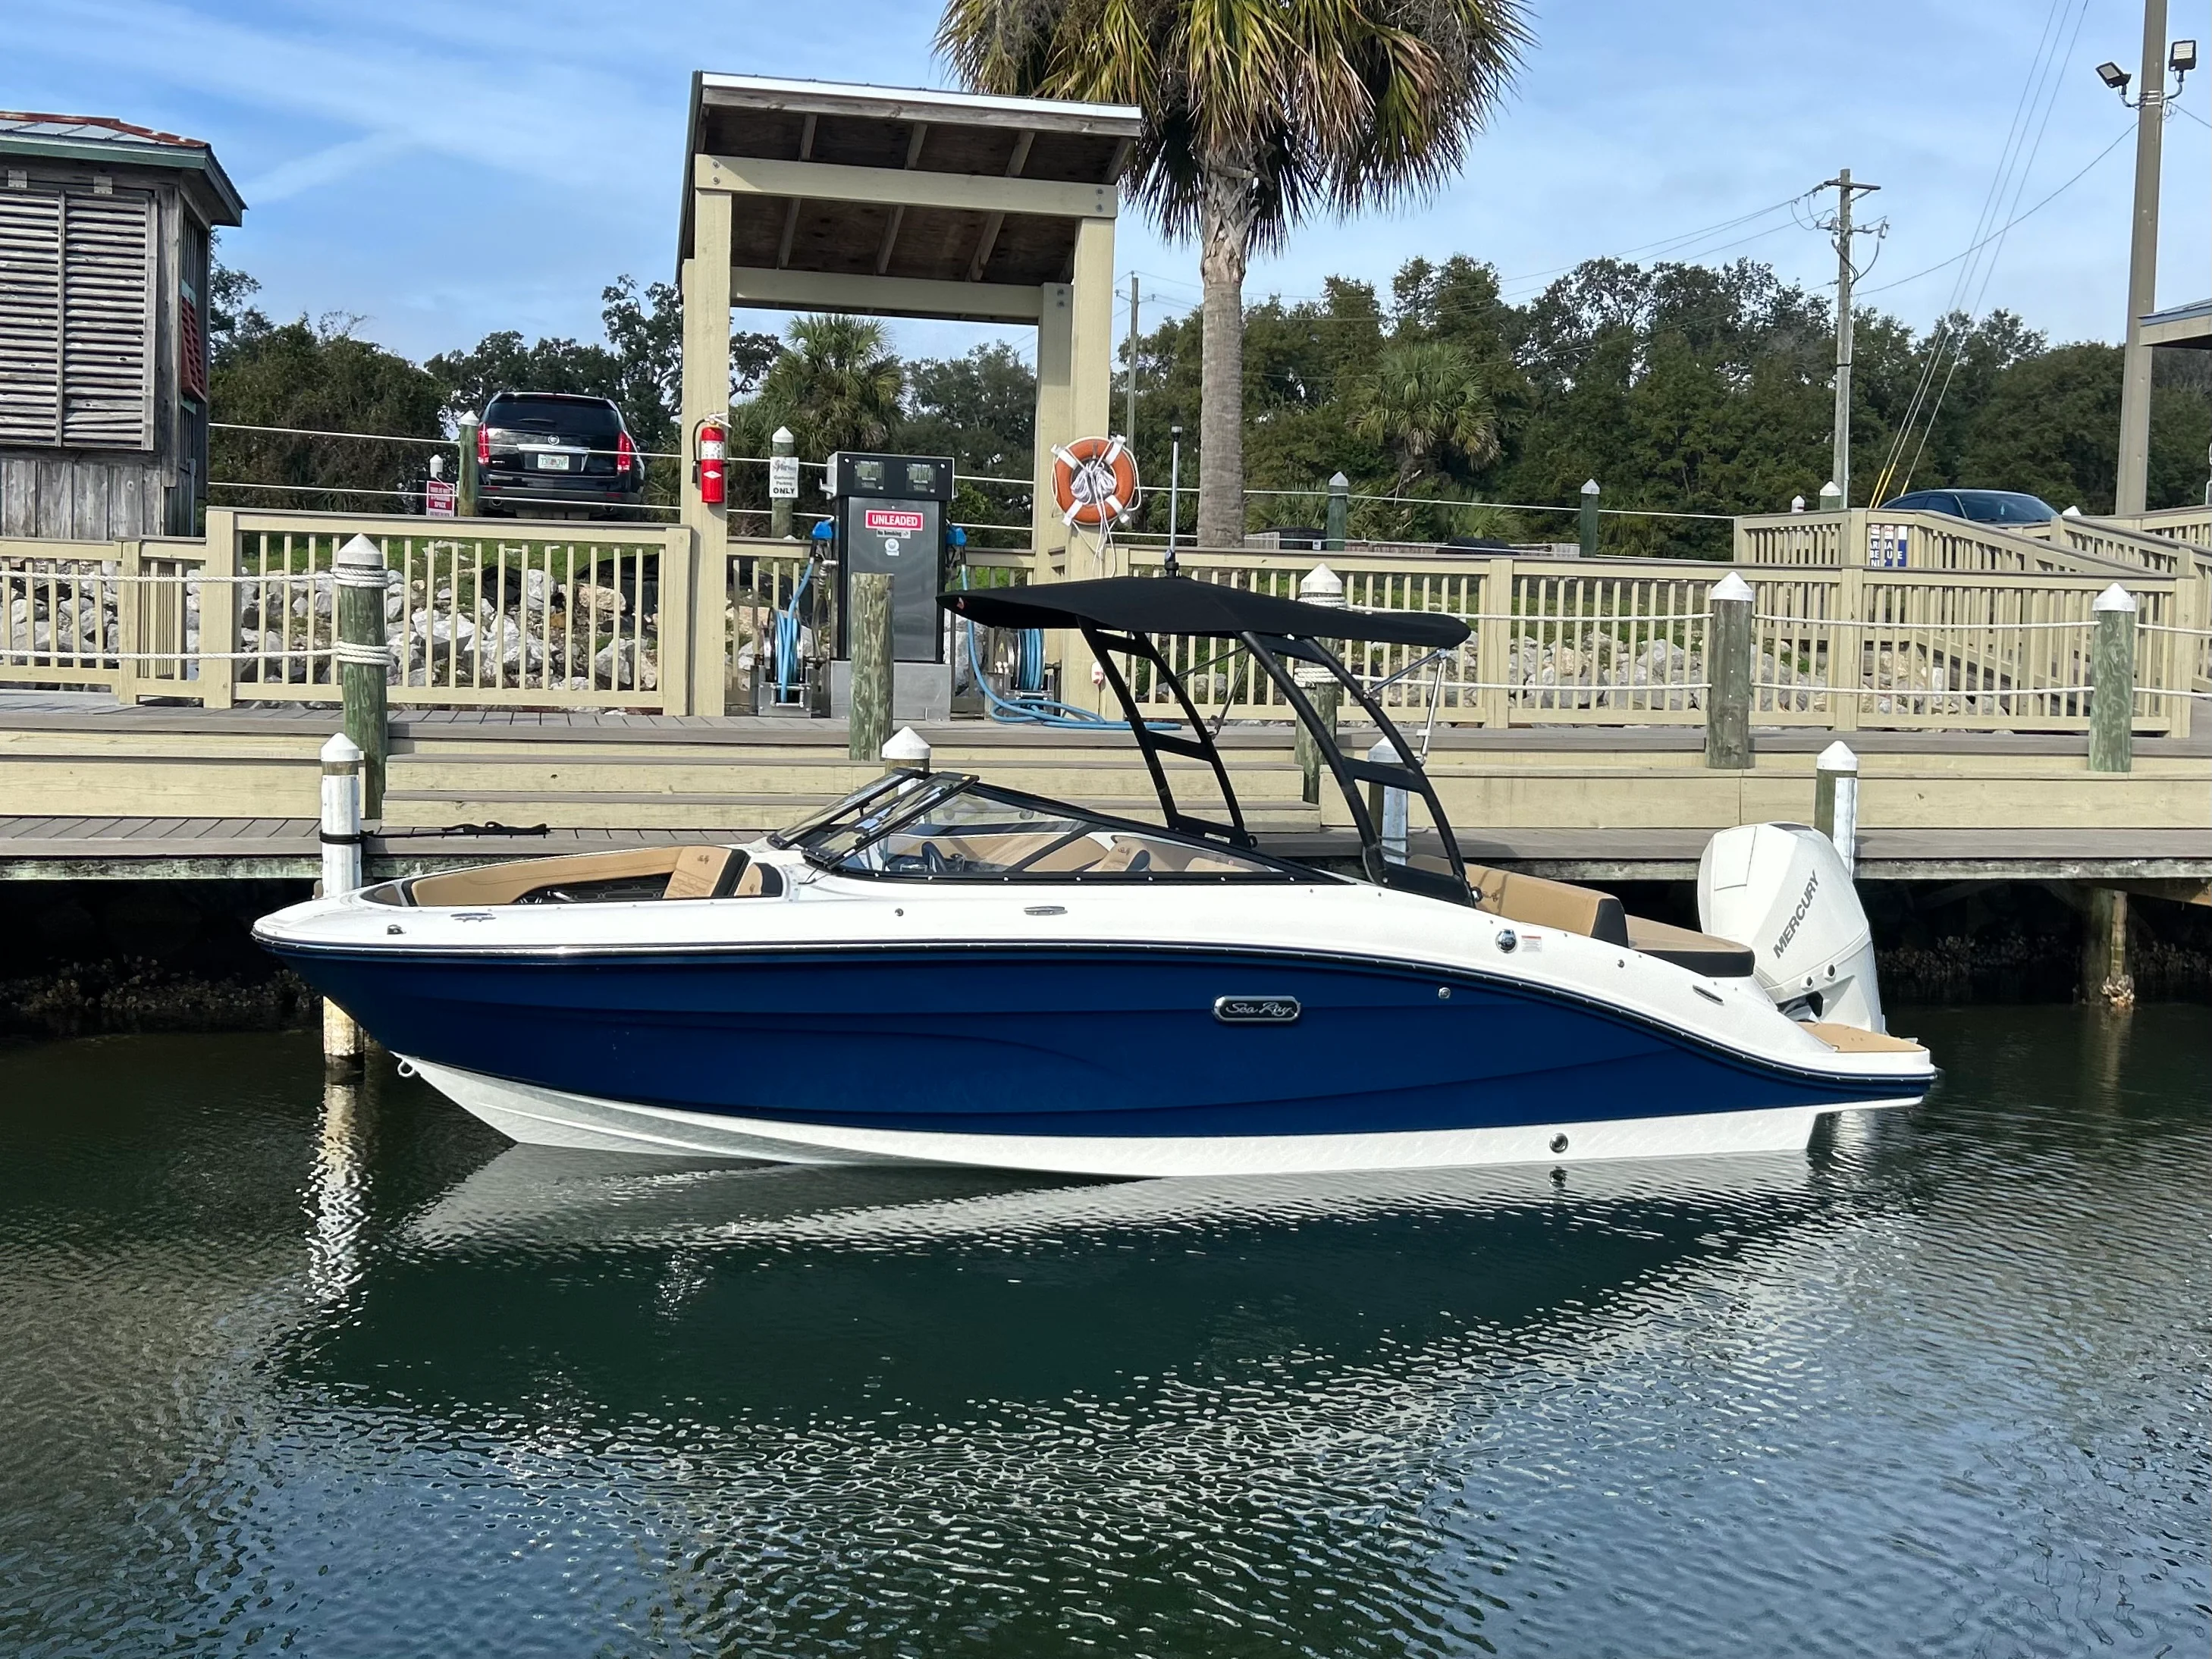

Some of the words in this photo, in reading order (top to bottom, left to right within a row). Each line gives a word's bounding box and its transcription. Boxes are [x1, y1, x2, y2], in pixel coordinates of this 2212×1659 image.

[871, 514, 918, 527] UNLEADED
[1773, 869, 1818, 959] MERCURY
[1225, 1002, 1259, 1014] Sea
[1259, 1002, 1293, 1017] Ray
